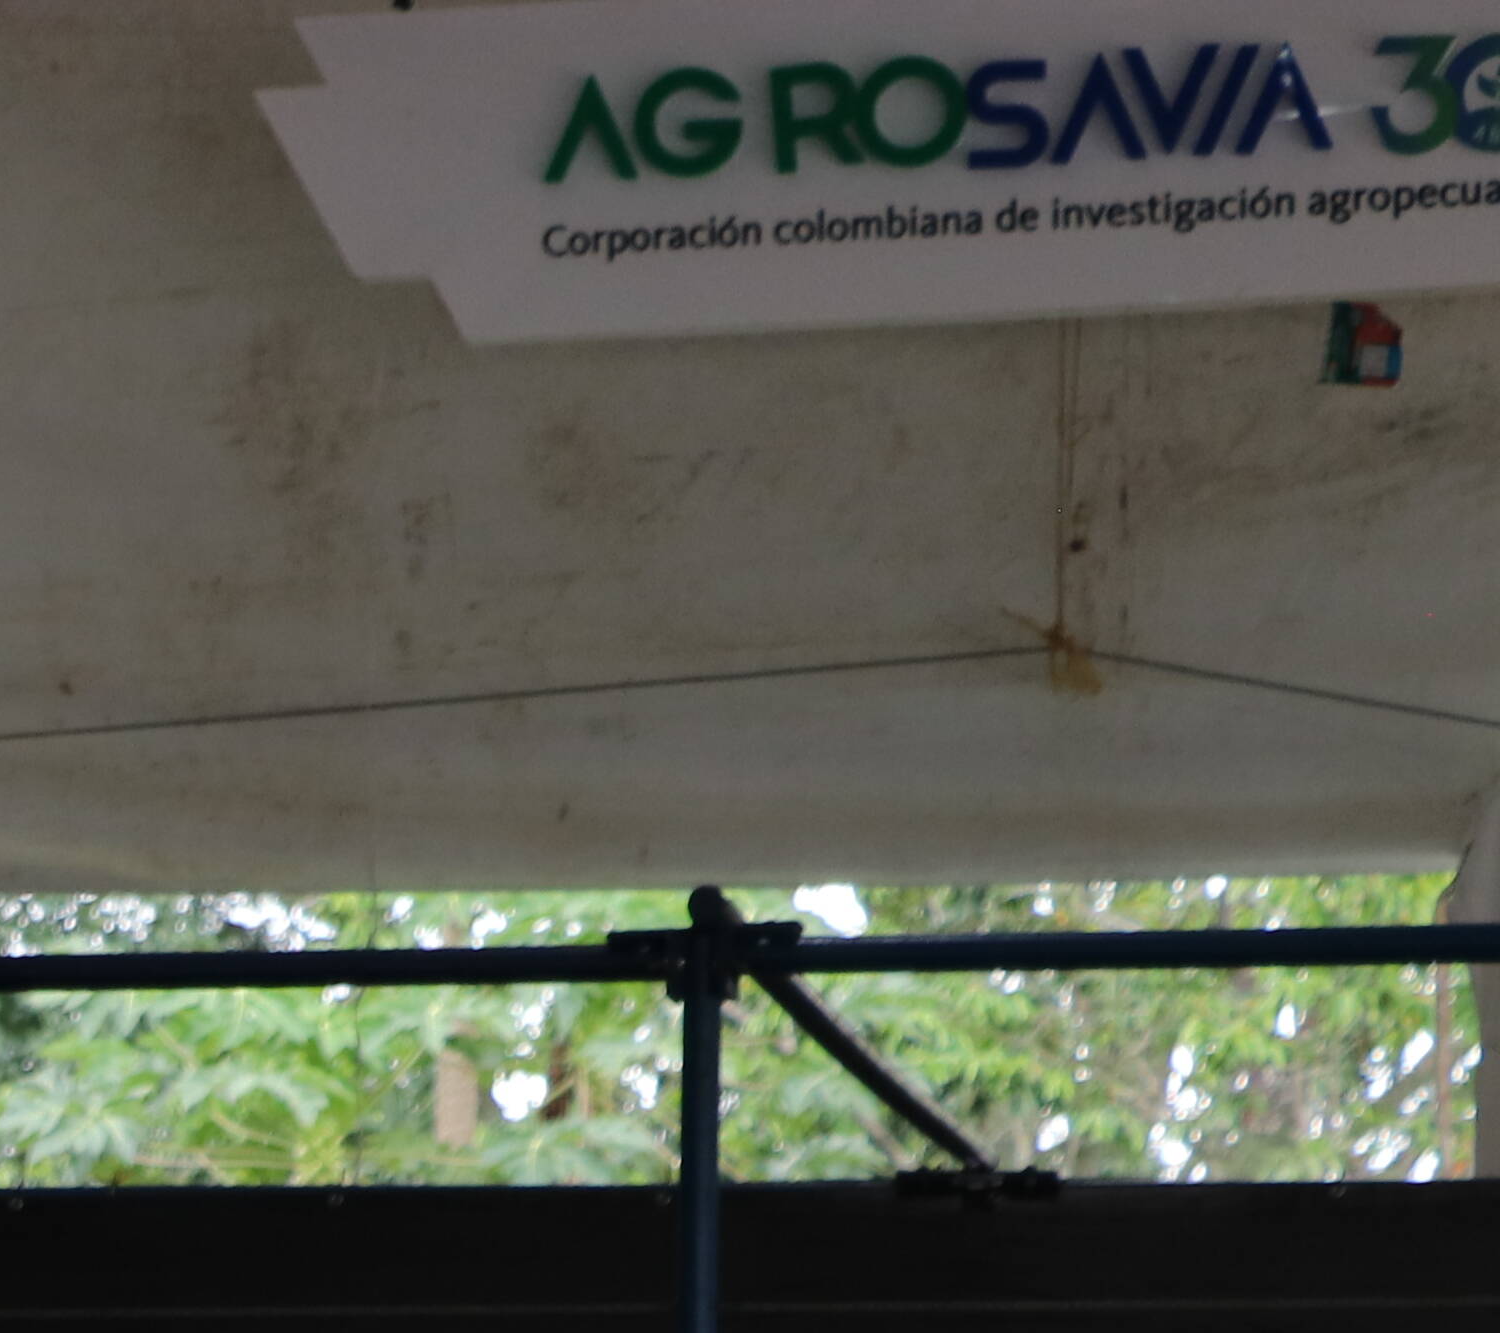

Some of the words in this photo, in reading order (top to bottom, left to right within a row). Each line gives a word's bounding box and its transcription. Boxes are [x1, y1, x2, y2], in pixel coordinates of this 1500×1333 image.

[542, 41, 1332, 184] AGROSAVIA
[542, 215, 762, 261] Corporación
[774, 205, 983, 245] colombiana
[996, 198, 1039, 233] de
[1051, 187, 1296, 233] investigación
